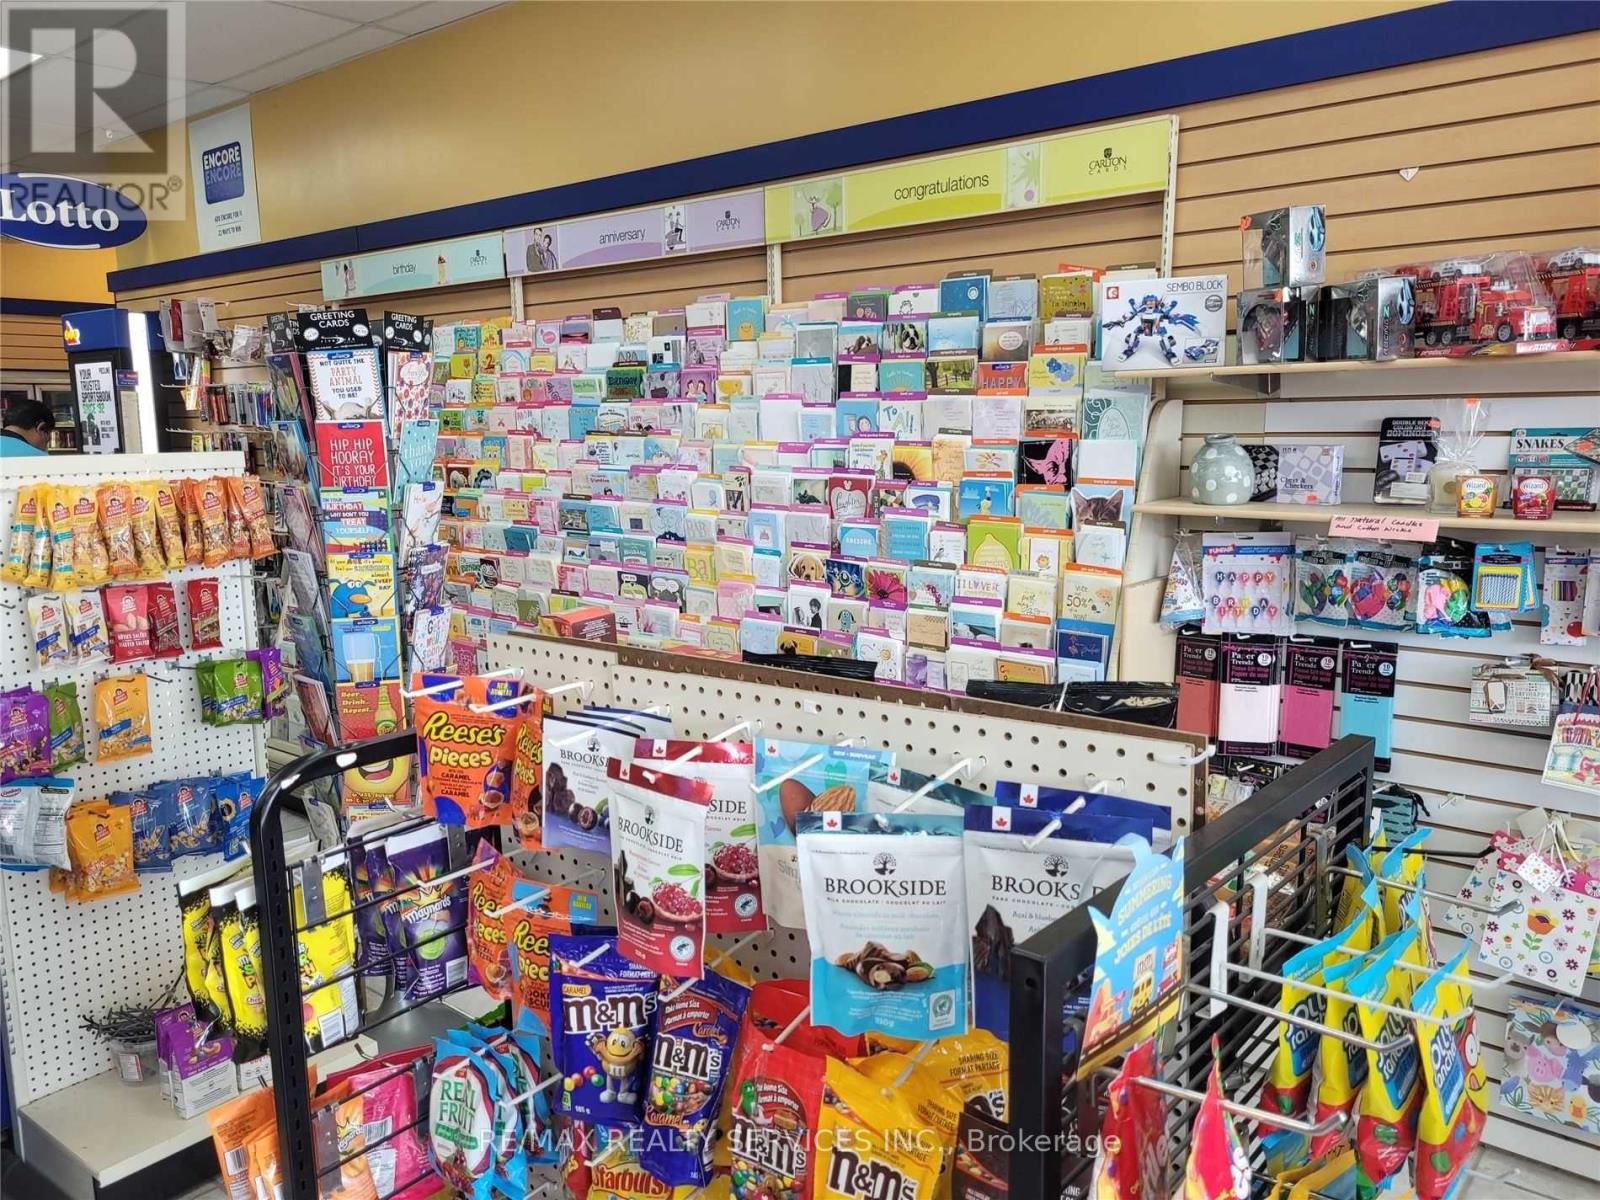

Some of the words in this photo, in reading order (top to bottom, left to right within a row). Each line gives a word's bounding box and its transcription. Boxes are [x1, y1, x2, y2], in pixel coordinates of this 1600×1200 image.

[203, 146, 241, 170] ENCORE
[1089, 155, 1126, 170] CARLTON
[205, 163, 242, 185] ENCORE
[894, 174, 989, 201] congratulations
[0, 190, 120, 232] Lotto
[599, 226, 647, 245] anniversary
[392, 263, 417, 275] birthday
[1166, 282, 1195, 293] SEMBO
[1196, 280, 1223, 291] BLOCK
[310, 311, 355, 321] GREETING
[391, 313, 417, 324] GREETING
[318, 319, 350, 328] CARDS
[395, 321, 413, 330] CARDS
[486, 354, 494, 369] 2
[330, 366, 357, 376] PARTY
[329, 376, 363, 387] ANIMAL
[982, 376, 1021, 388] HAPPY
[81, 391, 111, 402] SPORTSBOOK
[883, 405, 897, 421] To
[329, 439, 352, 450] HIP
[353, 438, 373, 450] HIP
[402, 441, 432, 458] thank
[1516, 439, 1564, 449] SNAKES
[330, 450, 375, 464] HOORAY
[332, 465, 350, 476] IT'S
[353, 464, 375, 475] YOUR
[333, 475, 377, 487] BIRTHDAY
[325, 503, 363, 511] BIRTHDAY
[341, 517, 367, 525] TREAT
[1216, 572, 1275, 581] HAPPY
[1066, 594, 1088, 608] 50%
[423, 711, 505, 745] Reese's
[429, 746, 493, 768] pieces
[559, 749, 608, 767] BROOKSI
[441, 772, 472, 781] CARAMEL
[440, 789, 470, 798] CARAMEL
[617, 816, 684, 854] BROOKSIDE
[825, 877, 947, 898] BROOKSIDE
[992, 875, 1104, 902] BROOKSD
[402, 894, 451, 924] Maynards
[475, 917, 507, 944] ieces
[563, 985, 587, 994] CARAMEL
[958, 1053, 984, 1065] SHARING
[985, 1051, 998, 1062] SIZE
[950, 1066, 973, 1076] FORMAT
[975, 1062, 1001, 1072] PARTAGE
[441, 1080, 476, 1112] REAL
[440, 1101, 476, 1134] FRUIT
[946, 1108, 957, 1121] SIZE
